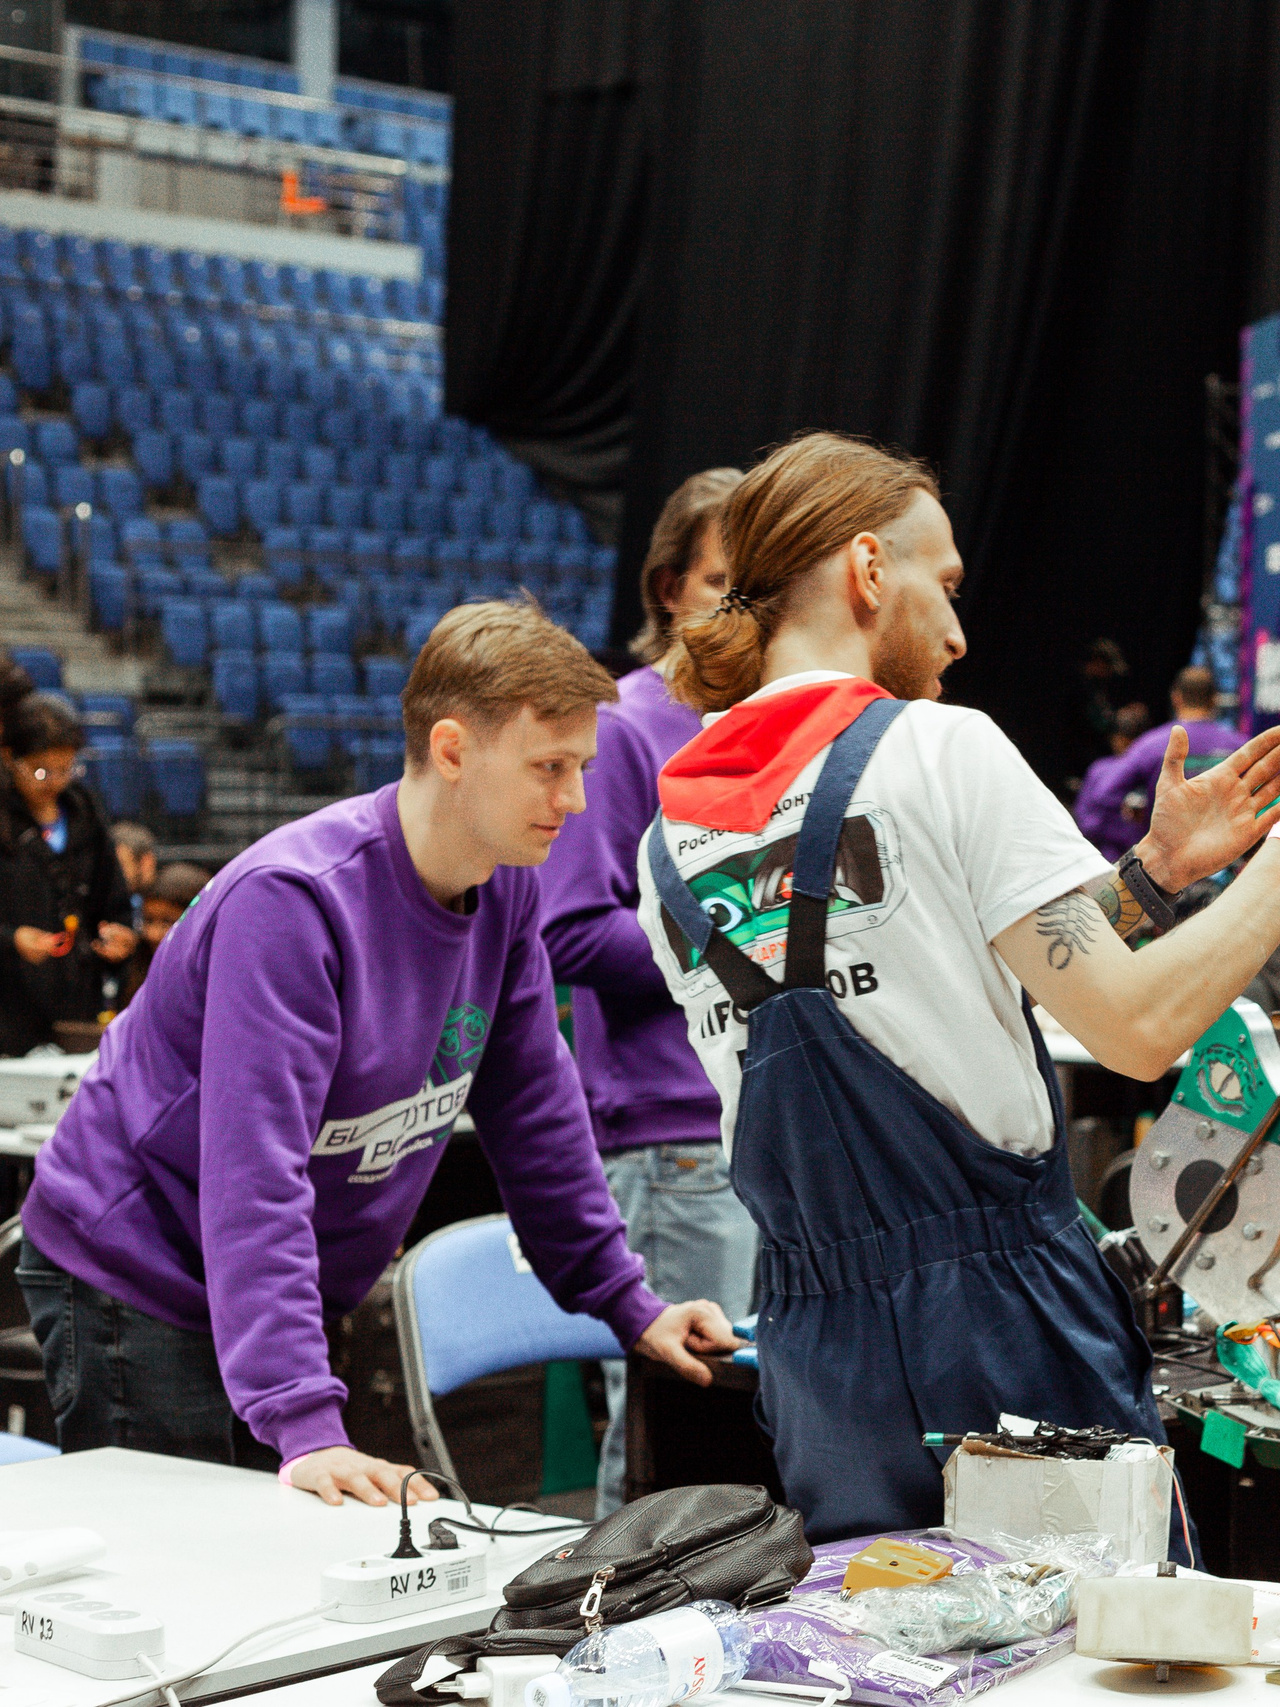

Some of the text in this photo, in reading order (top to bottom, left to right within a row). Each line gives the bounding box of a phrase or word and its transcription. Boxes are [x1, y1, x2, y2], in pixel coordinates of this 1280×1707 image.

[390, 1573, 411, 1599] RV
[417, 1567, 436, 1592] 23
[21, 1610, 54, 1640] RV 23
[682, 1656, 707, 1701] SSAY
